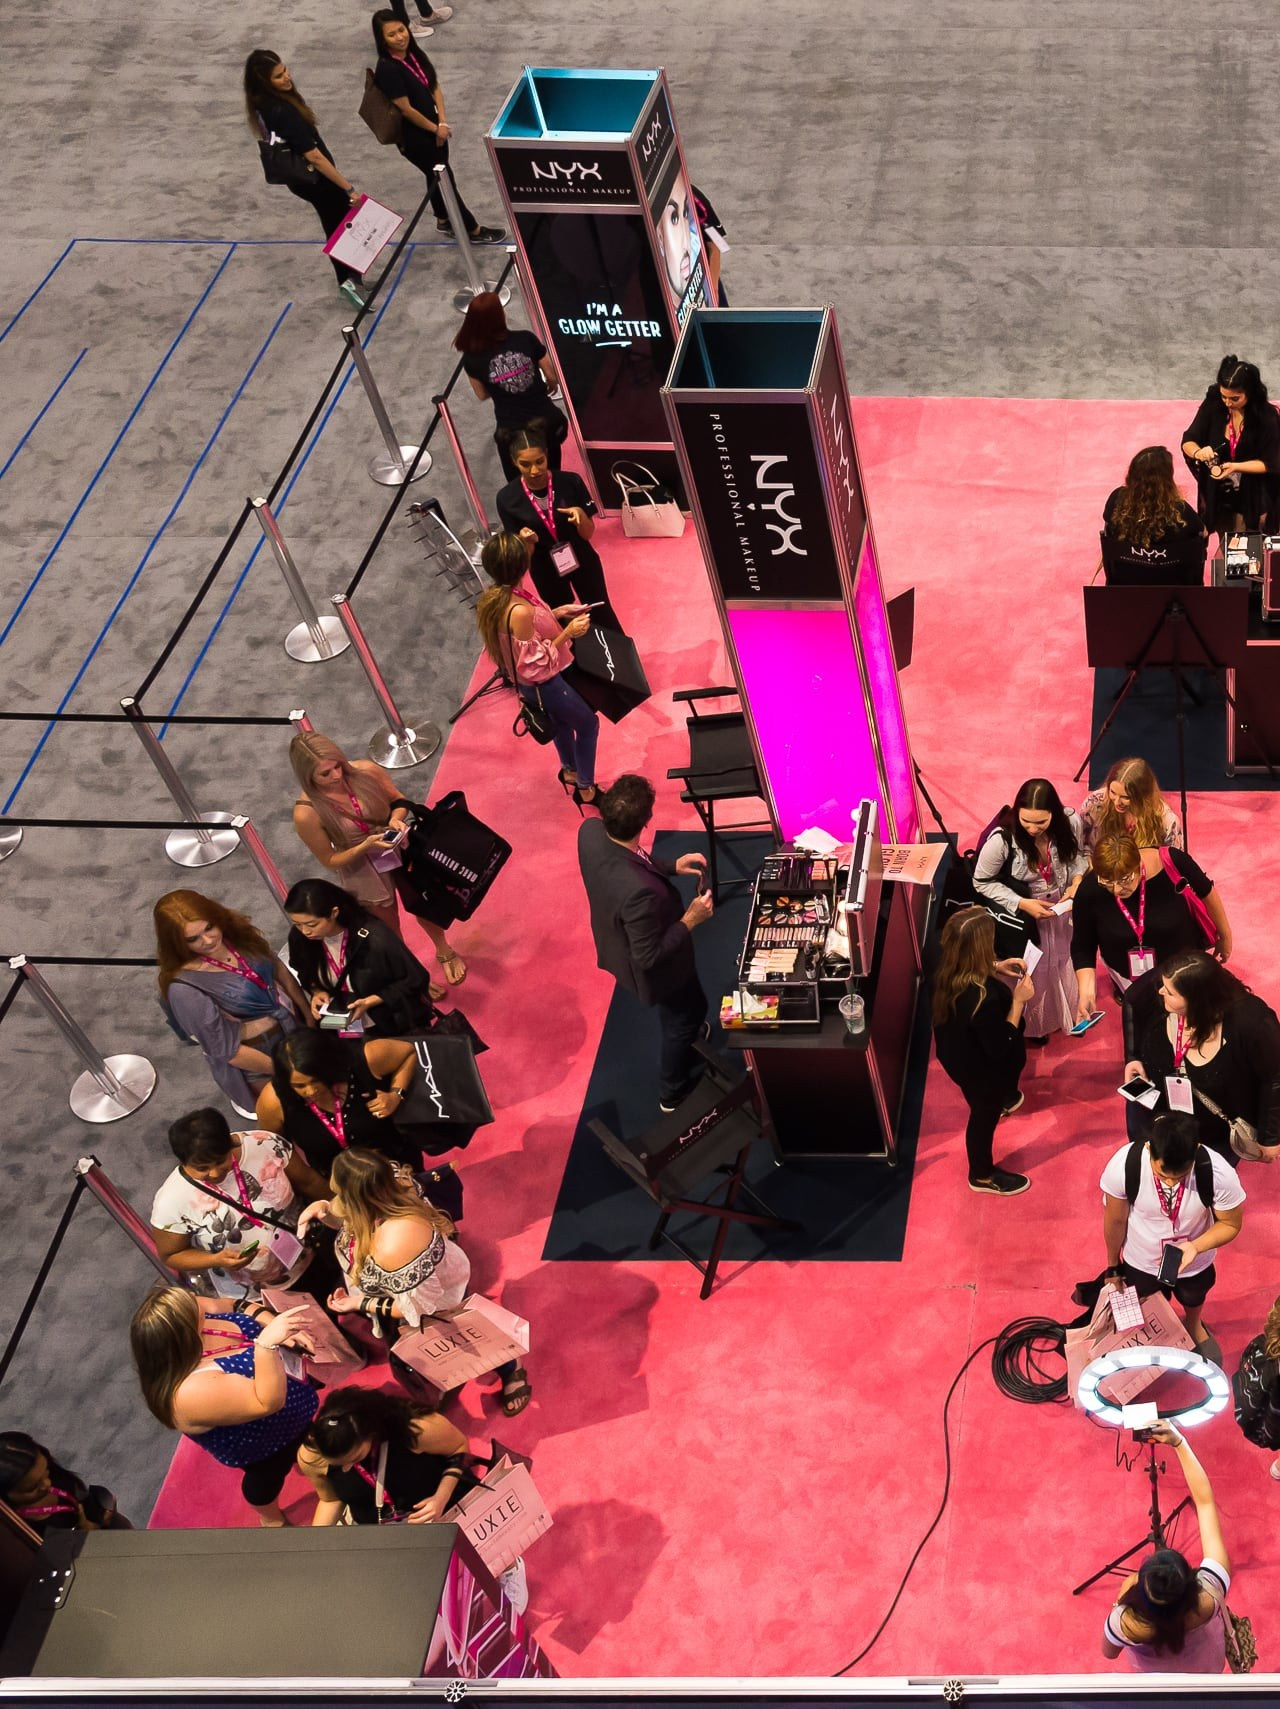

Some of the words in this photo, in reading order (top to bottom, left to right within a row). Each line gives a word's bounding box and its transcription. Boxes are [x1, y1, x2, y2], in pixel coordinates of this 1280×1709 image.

[531, 161, 602, 180] NYX
[513, 186, 588, 194] PROFESSIONAL
[586, 302, 609, 316] I'M
[612, 303, 623, 317] A
[558, 318, 601, 335] GLOW
[604, 320, 662, 337] GETTER
[830, 393, 855, 513] NYX
[709, 413, 746, 528] PROFESSIONAL
[739, 536, 761, 591] MAKEUP
[749, 455, 808, 556] NYX
[1131, 546, 1167, 558] NYX
[893, 849, 911, 865] BORN
[888, 866, 904, 874] TO
[679, 1108, 718, 1144] NYX
[424, 1327, 482, 1359] LUXIE
[474, 1494, 520, 1548] UXIE
